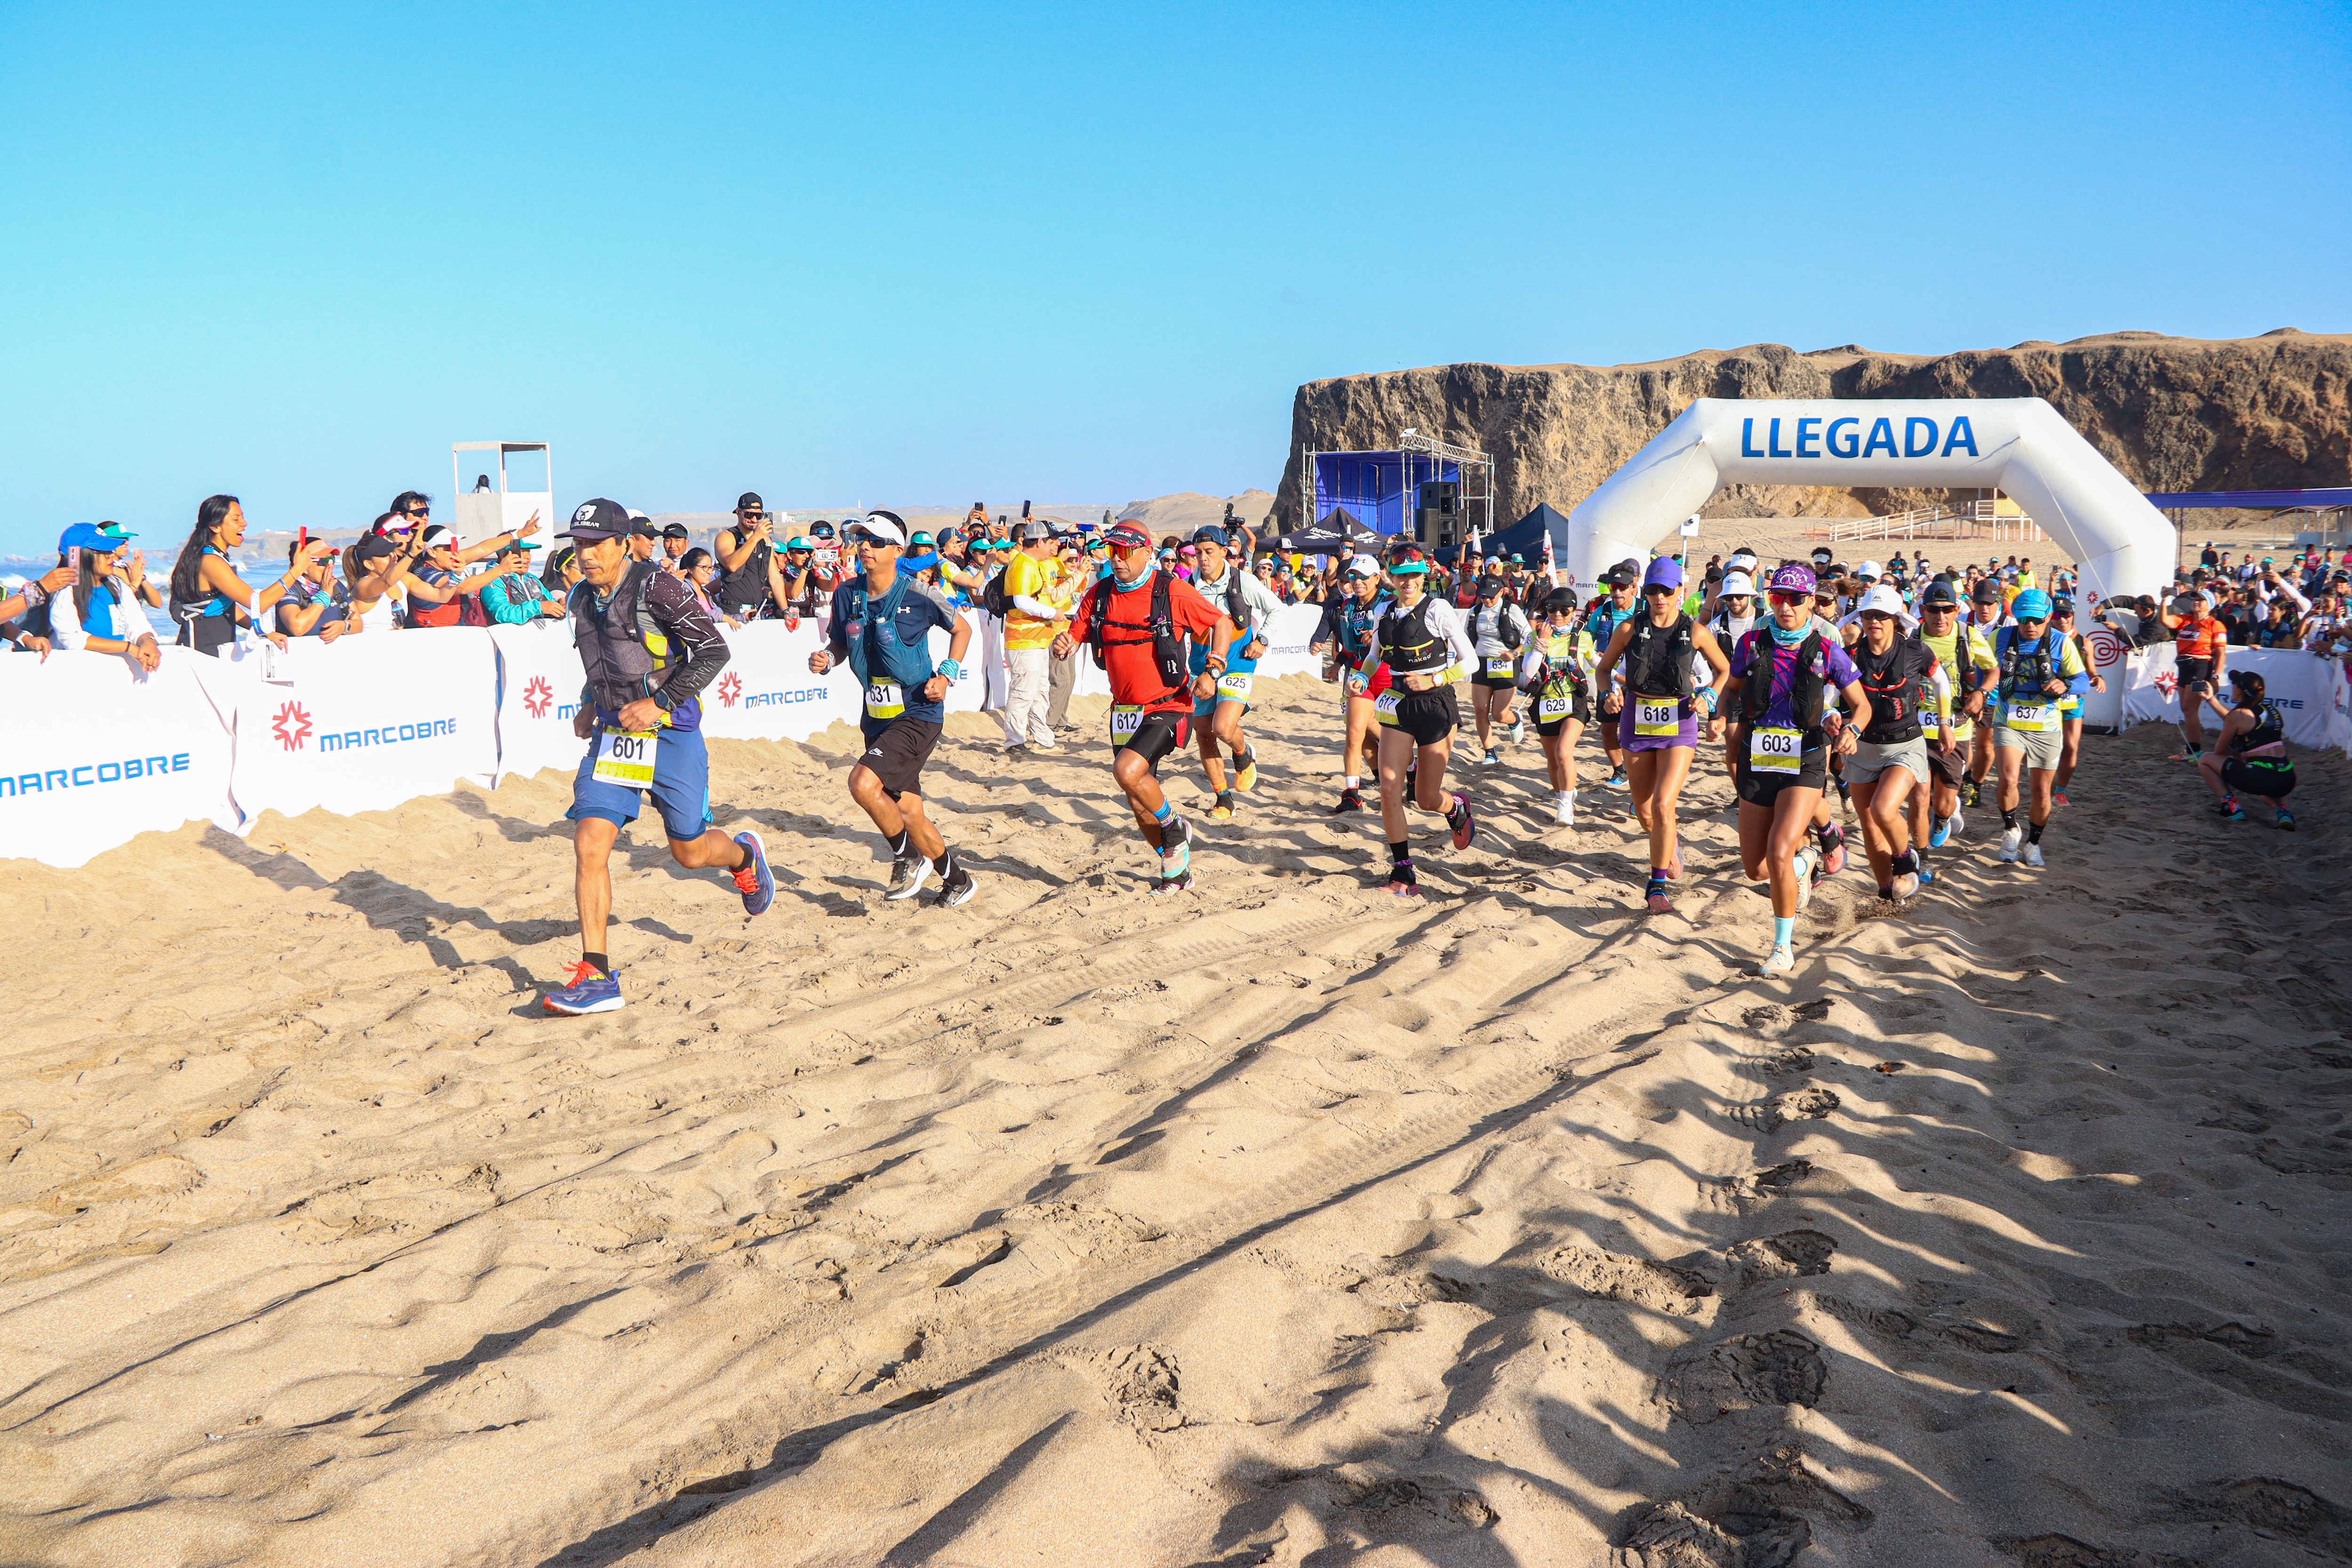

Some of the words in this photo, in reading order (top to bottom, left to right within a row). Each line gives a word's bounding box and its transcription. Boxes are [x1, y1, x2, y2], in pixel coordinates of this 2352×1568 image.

[1741, 416, 1979, 458] LLEGADA
[1309, 527, 1342, 538] Reebok
[1408, 652, 1432, 663] naked
[1492, 660, 1508, 669] 634
[1225, 677, 1246, 689] 625
[746, 687, 827, 709] MARCOBRE
[870, 685, 891, 703] 631
[1378, 694, 1396, 710] 617
[1546, 699, 1565, 712] 629
[2016, 706, 2038, 719] 637
[1117, 713, 1137, 730] 612
[1644, 706, 1669, 722] 618
[1924, 712, 1939, 725] 63
[320, 717, 456, 752] MARCOBRE
[613, 736, 644, 760] 601
[1762, 734, 1791, 753] 603
